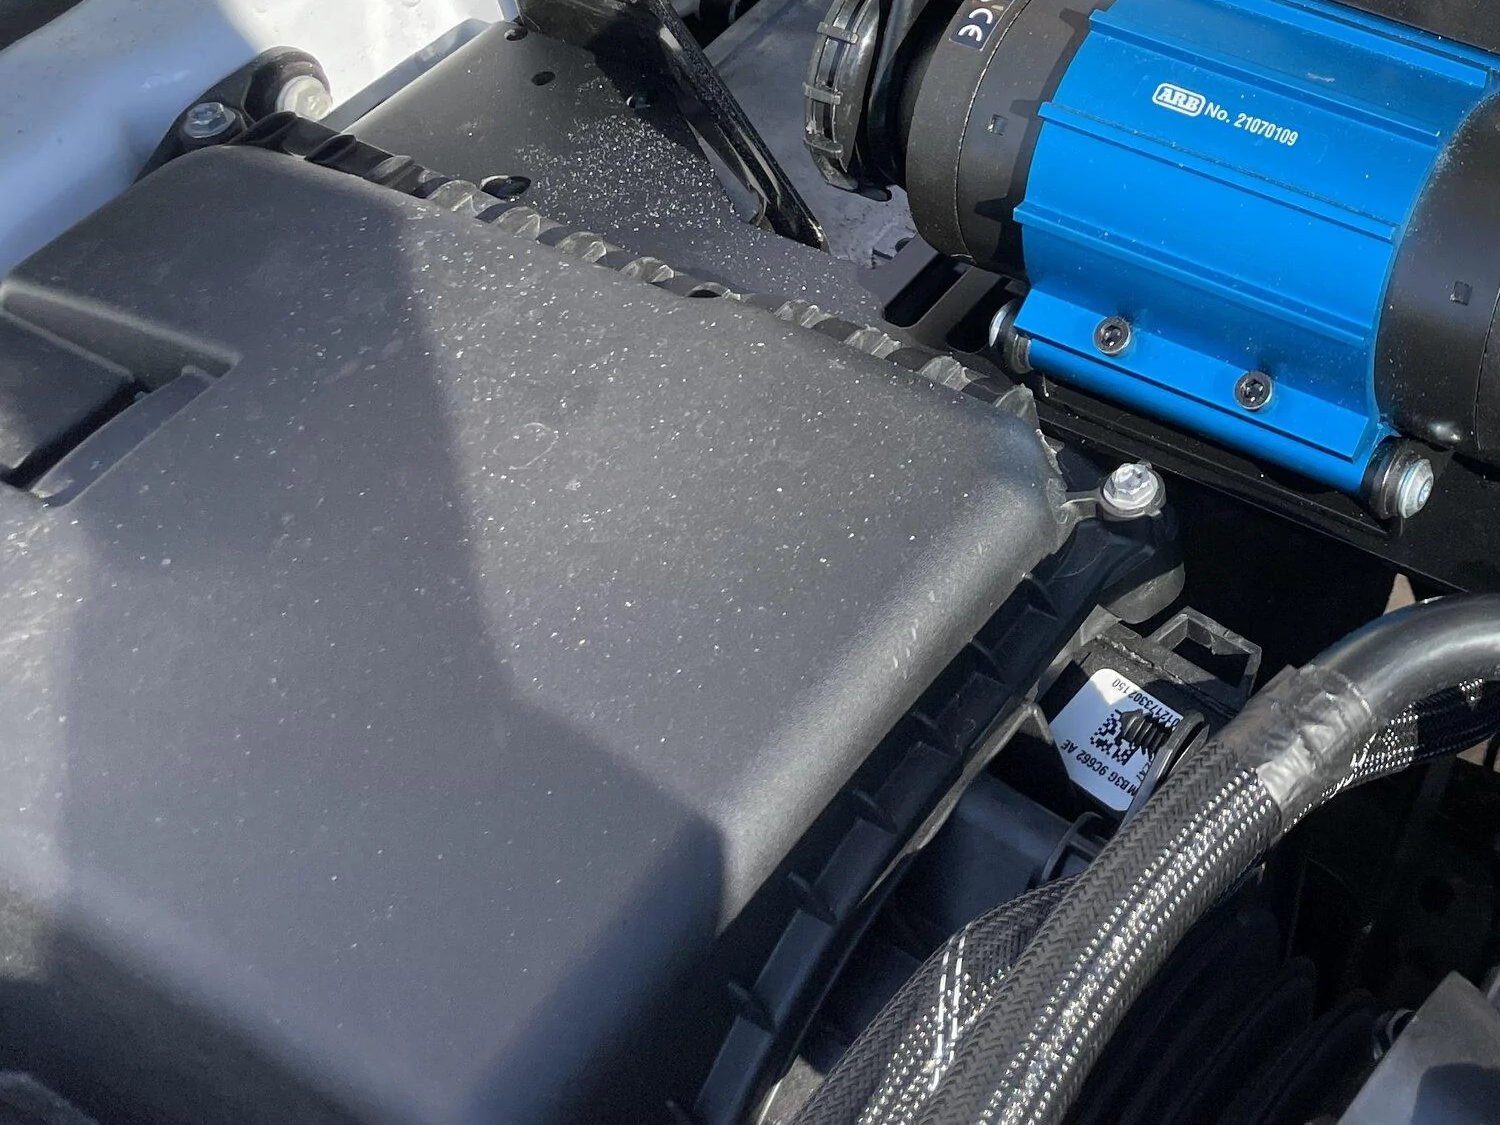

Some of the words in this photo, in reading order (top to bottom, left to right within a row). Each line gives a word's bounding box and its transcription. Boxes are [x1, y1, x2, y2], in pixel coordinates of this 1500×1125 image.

[1157, 87, 1201, 112] ARB
[1204, 102, 1231, 124] No.
[1233, 112, 1299, 147] 21070109
[1061, 738, 1079, 754] AE
[1075, 749, 1110, 776] 9C662
